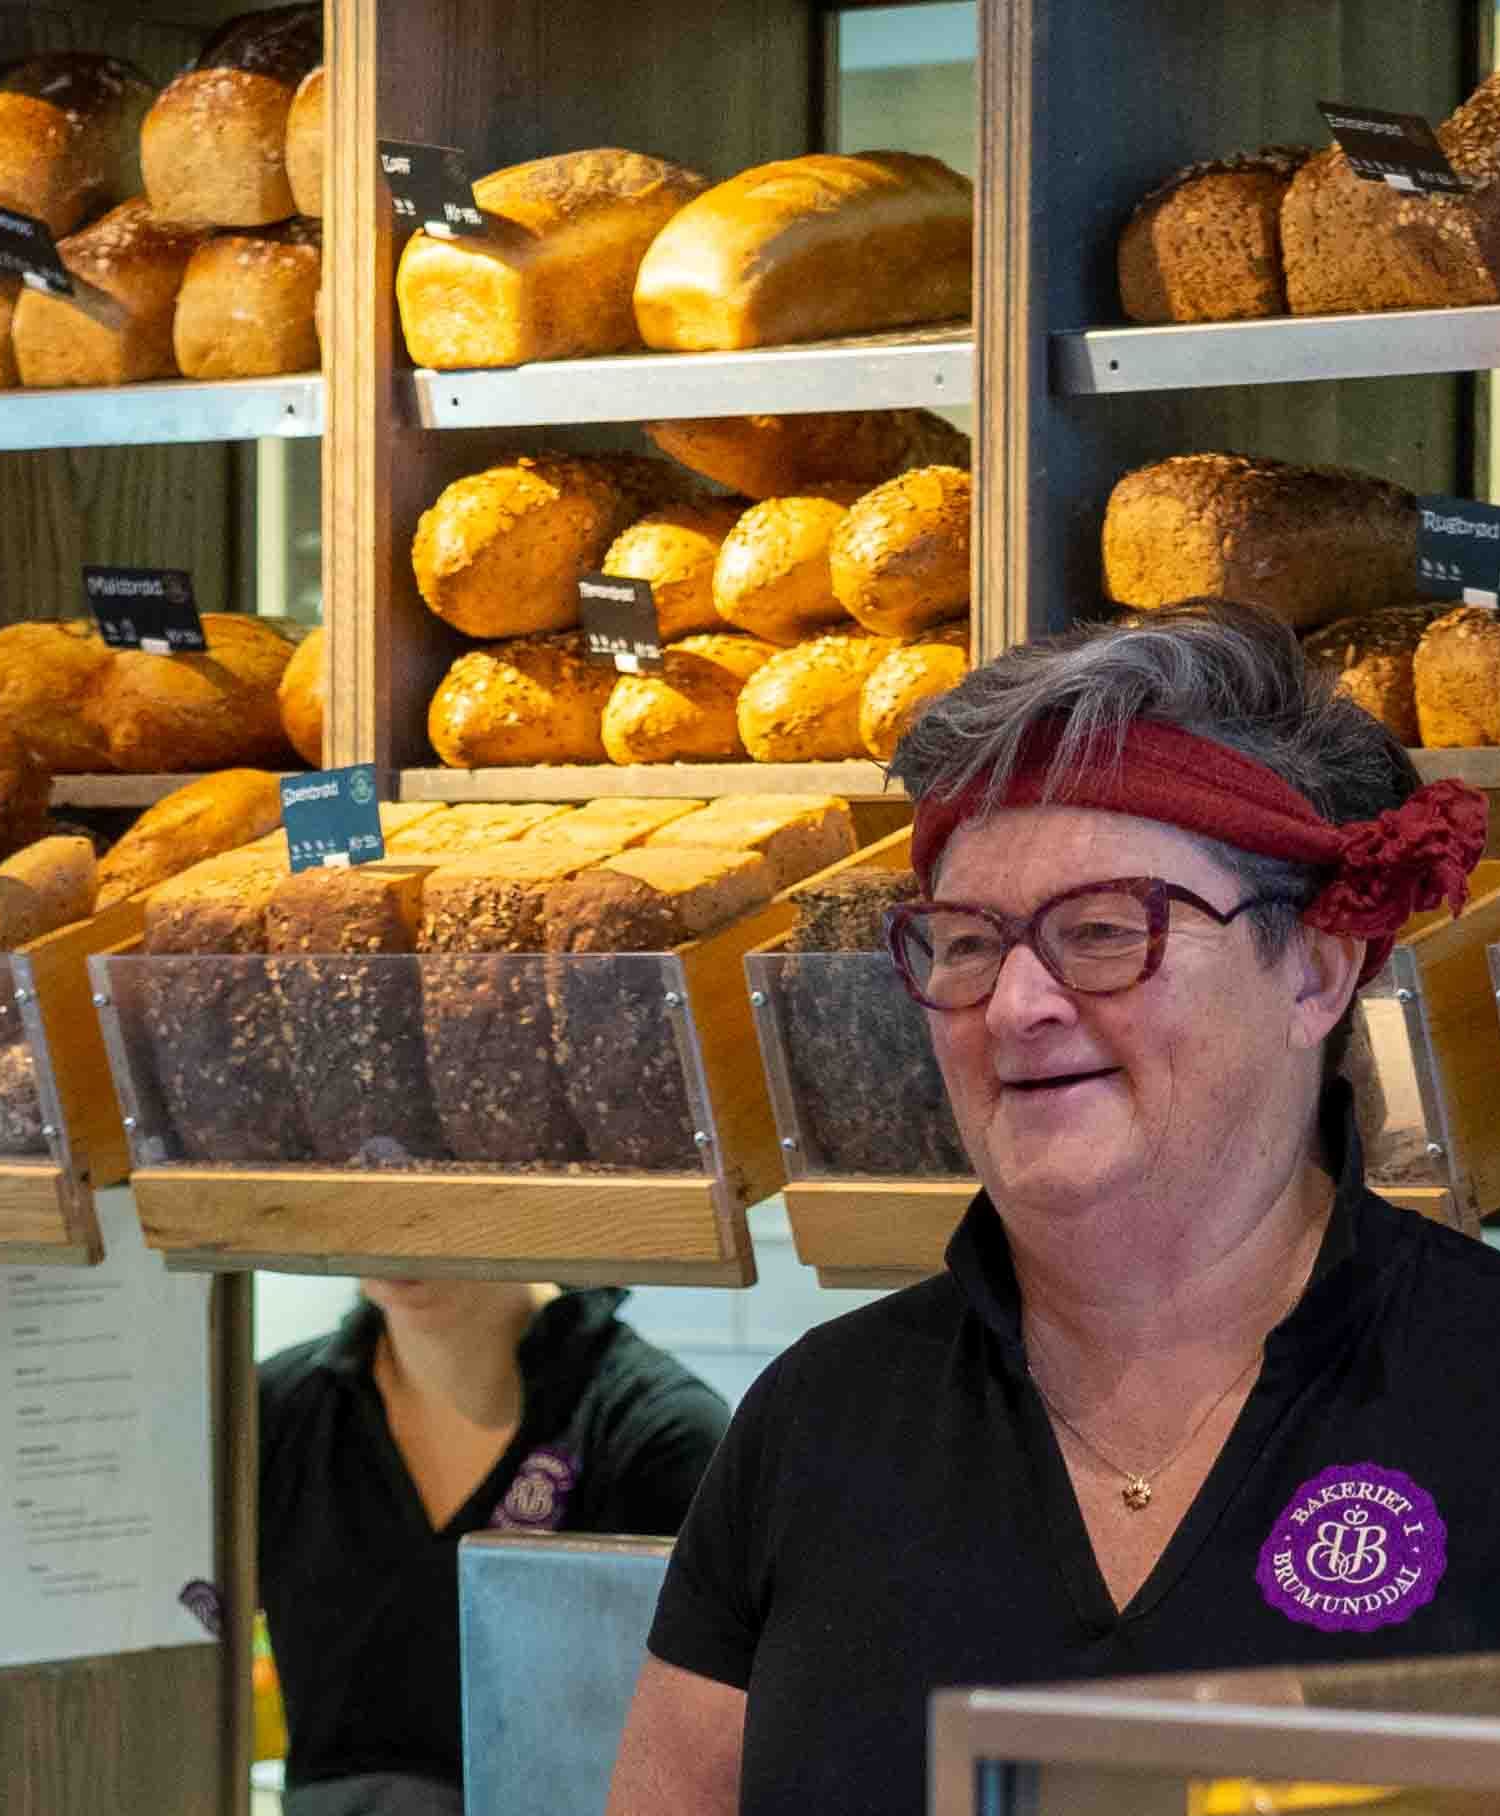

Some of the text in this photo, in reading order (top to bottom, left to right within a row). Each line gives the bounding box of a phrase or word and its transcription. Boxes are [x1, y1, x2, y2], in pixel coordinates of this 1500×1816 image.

[1421, 510, 1500, 541] Rugbrød
[1290, 1481, 1413, 1526] BAKERIET
[1272, 1550, 1423, 1615] BRUMUNDDAL
